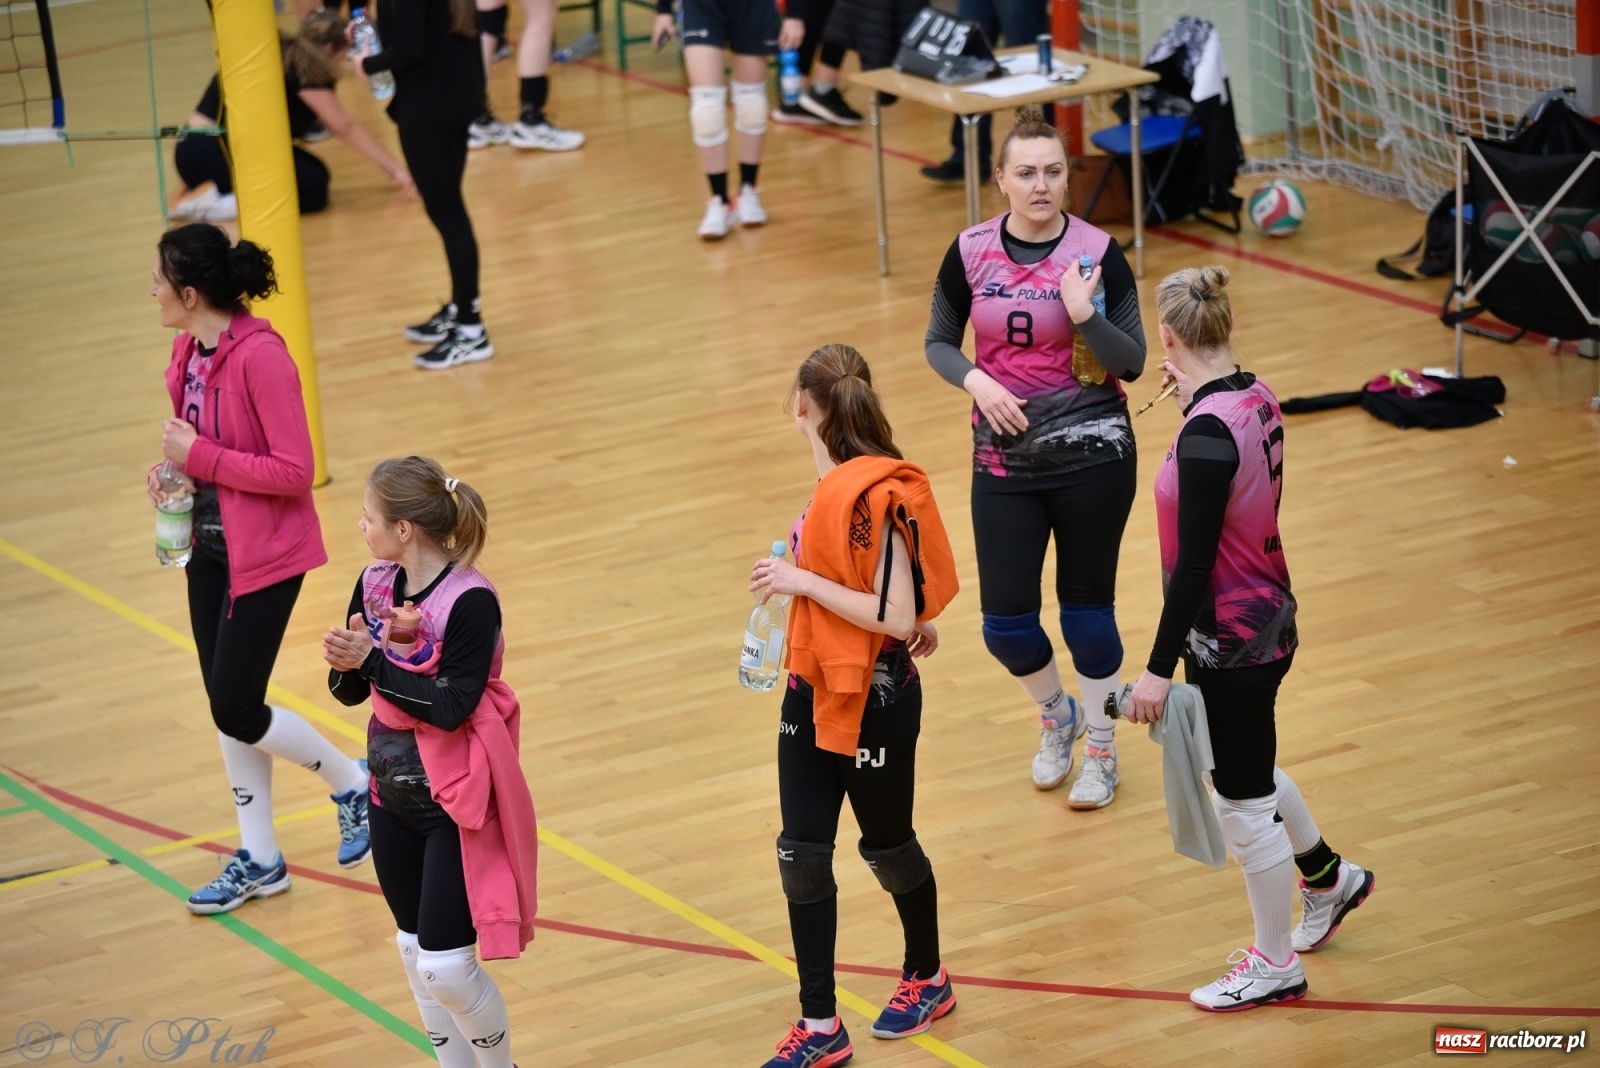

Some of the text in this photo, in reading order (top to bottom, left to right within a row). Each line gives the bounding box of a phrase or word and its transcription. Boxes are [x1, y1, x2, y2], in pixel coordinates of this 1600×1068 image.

[981, 282, 1013, 299] SL
[1006, 310, 1034, 349] 8
[855, 747, 886, 769] PJ
